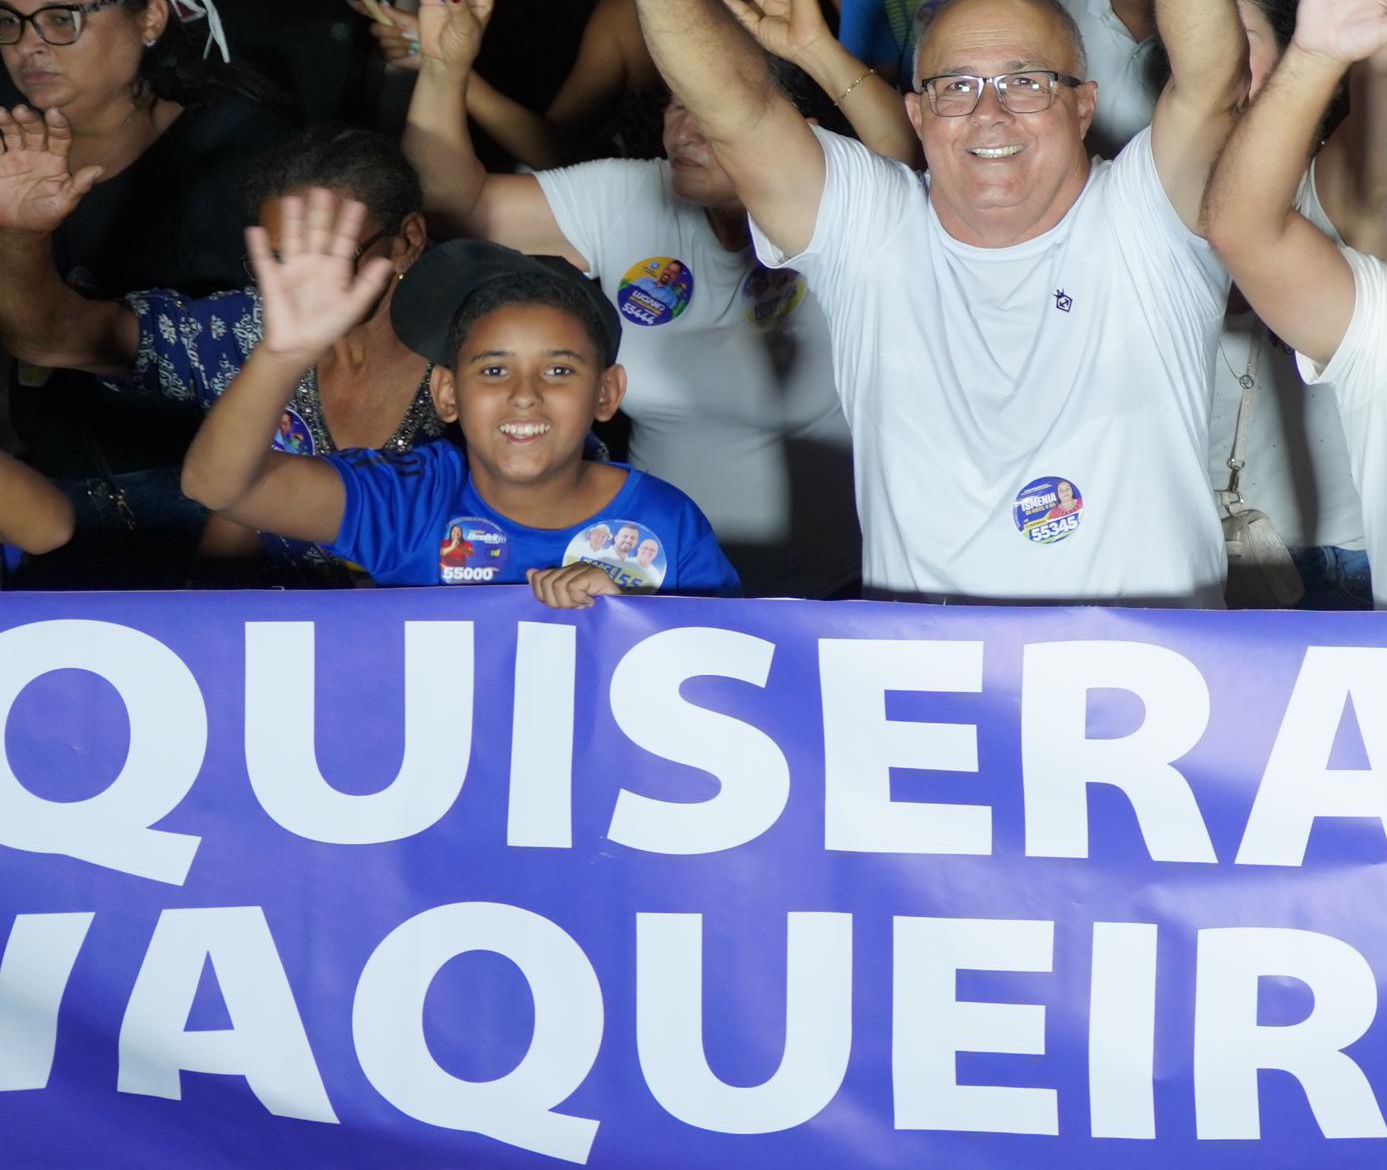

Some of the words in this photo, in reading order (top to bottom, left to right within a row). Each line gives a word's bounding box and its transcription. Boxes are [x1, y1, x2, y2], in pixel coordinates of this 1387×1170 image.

[1021, 492, 1057, 512] ISMENIA
[1031, 515, 1079, 541] 55345
[442, 566, 494, 581] 55000
